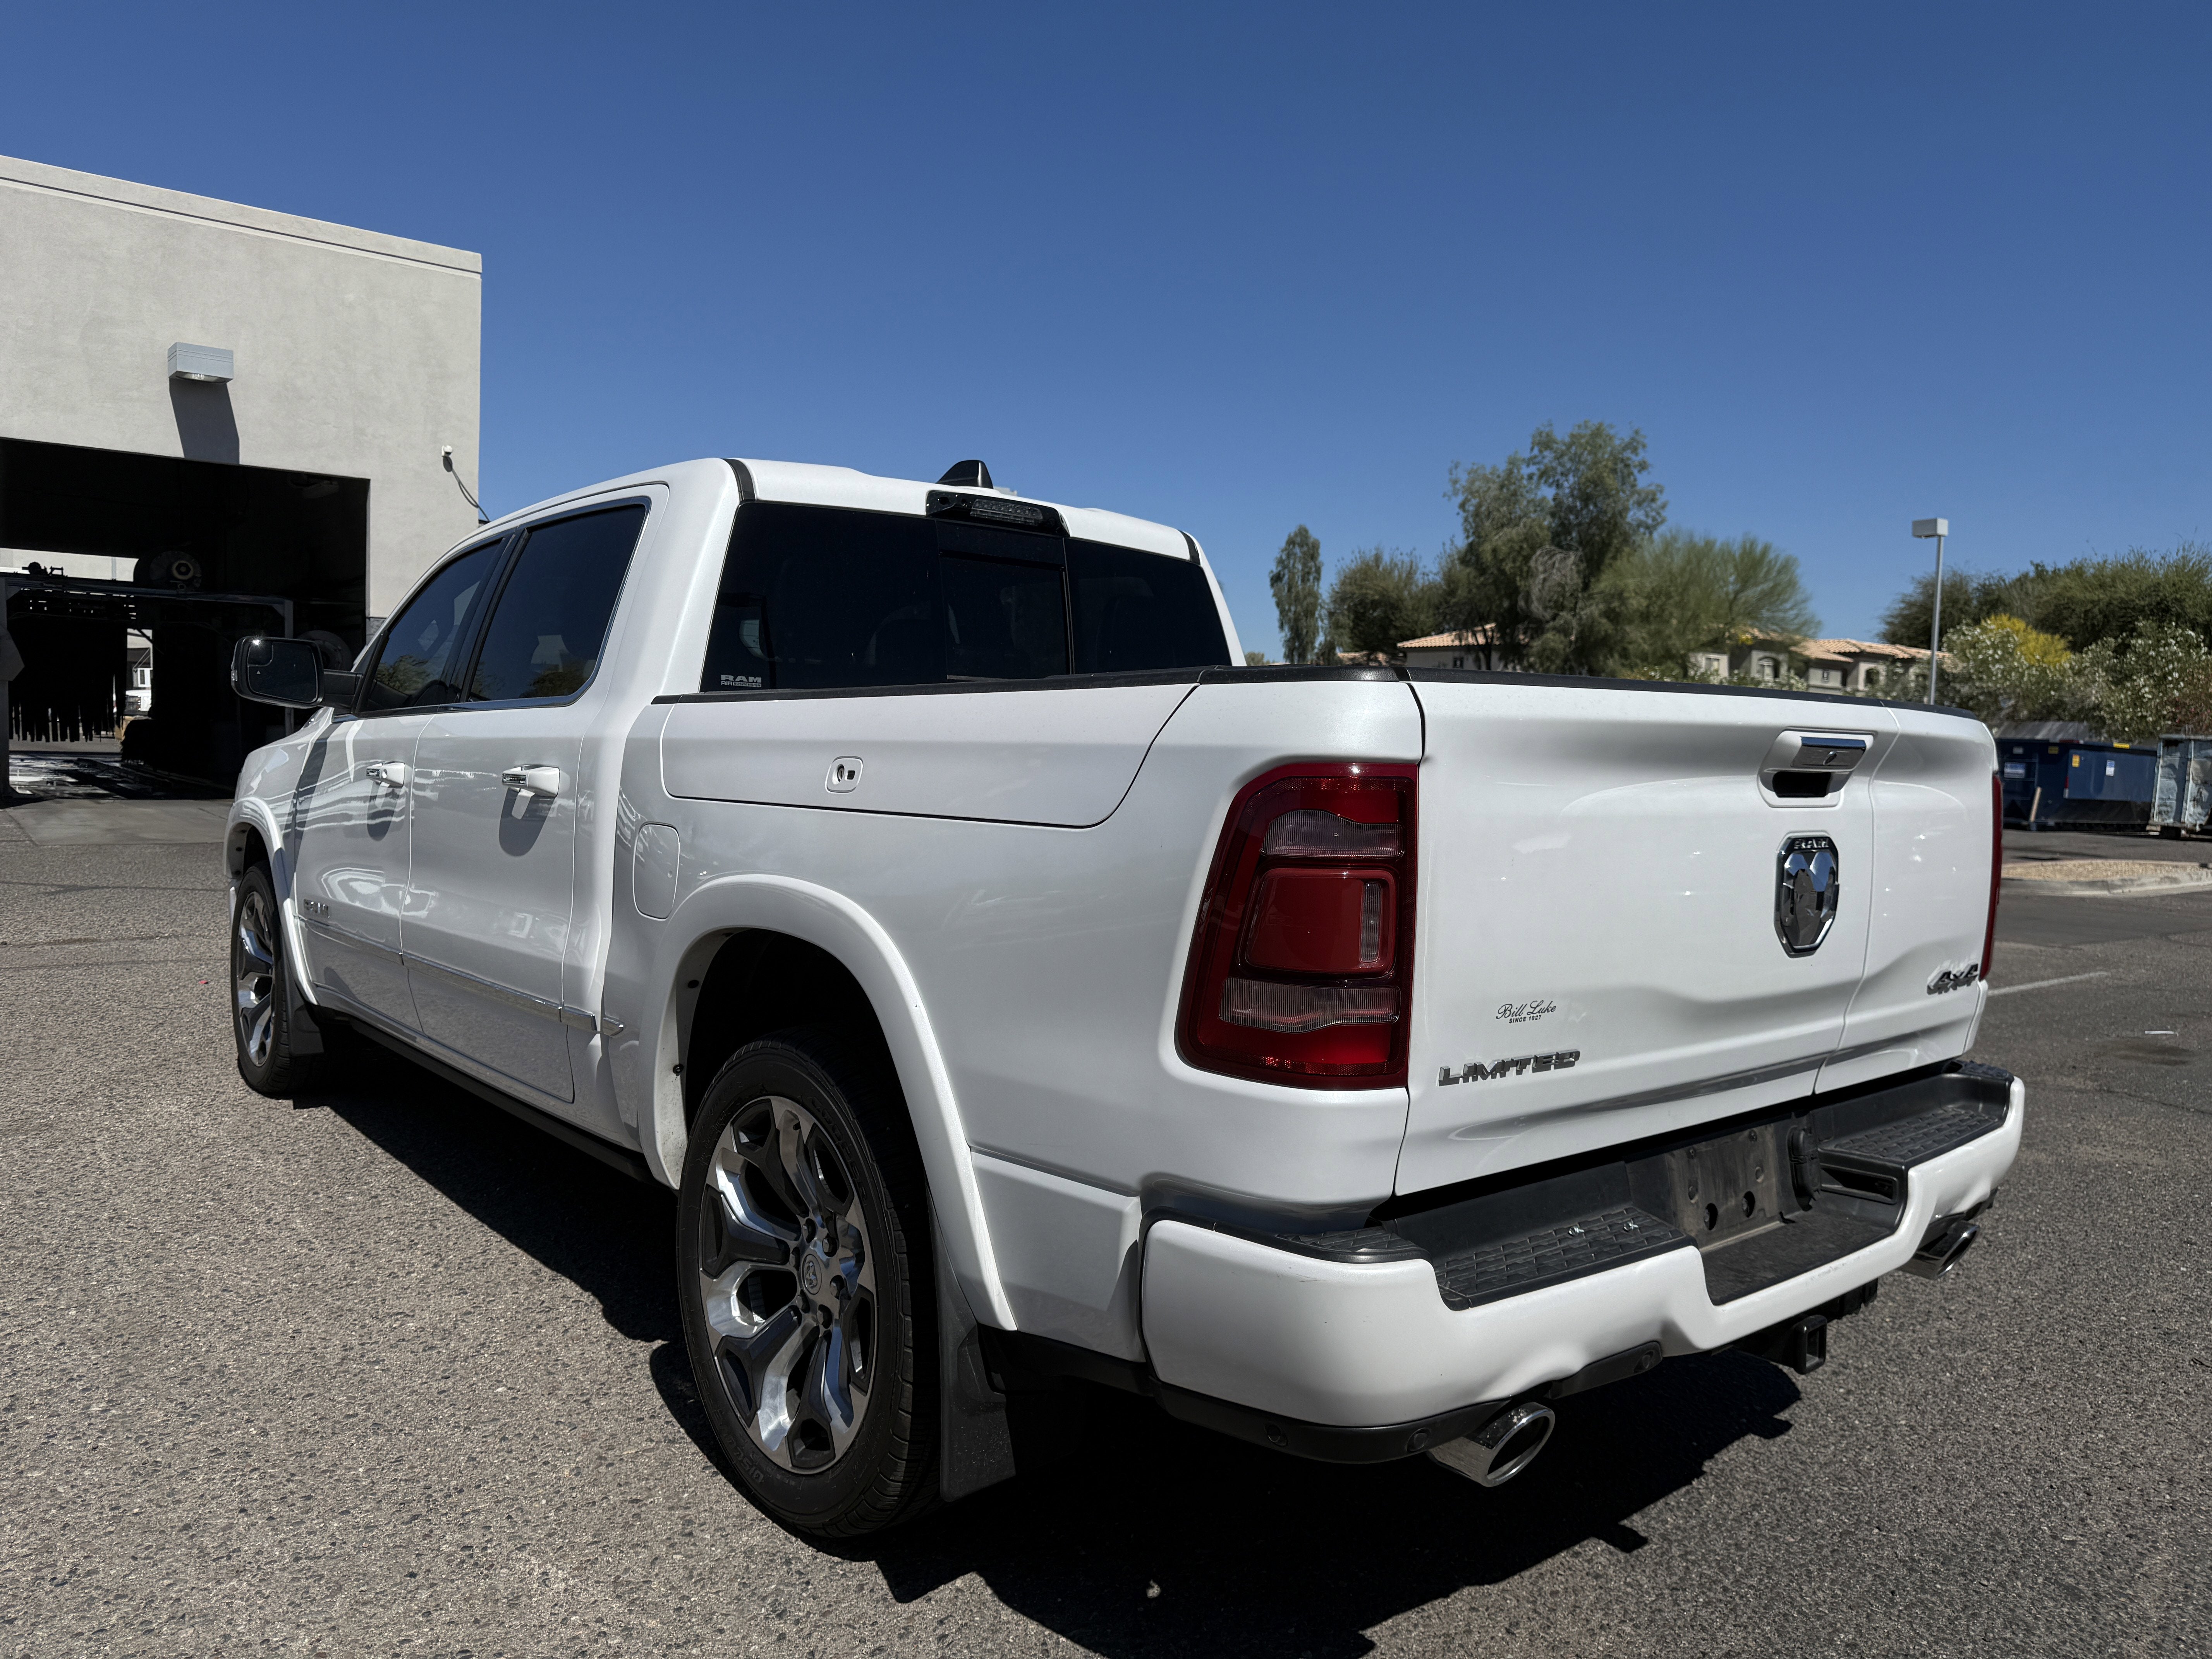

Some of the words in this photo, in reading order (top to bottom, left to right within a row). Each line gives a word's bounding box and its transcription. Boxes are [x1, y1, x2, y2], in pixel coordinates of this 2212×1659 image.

[721, 675, 762, 683] RAM
[1496, 1003, 1528, 1019] Bill
[1527, 1000, 1556, 1015] Luke
[1438, 1049, 1581, 1086] LIMITED
